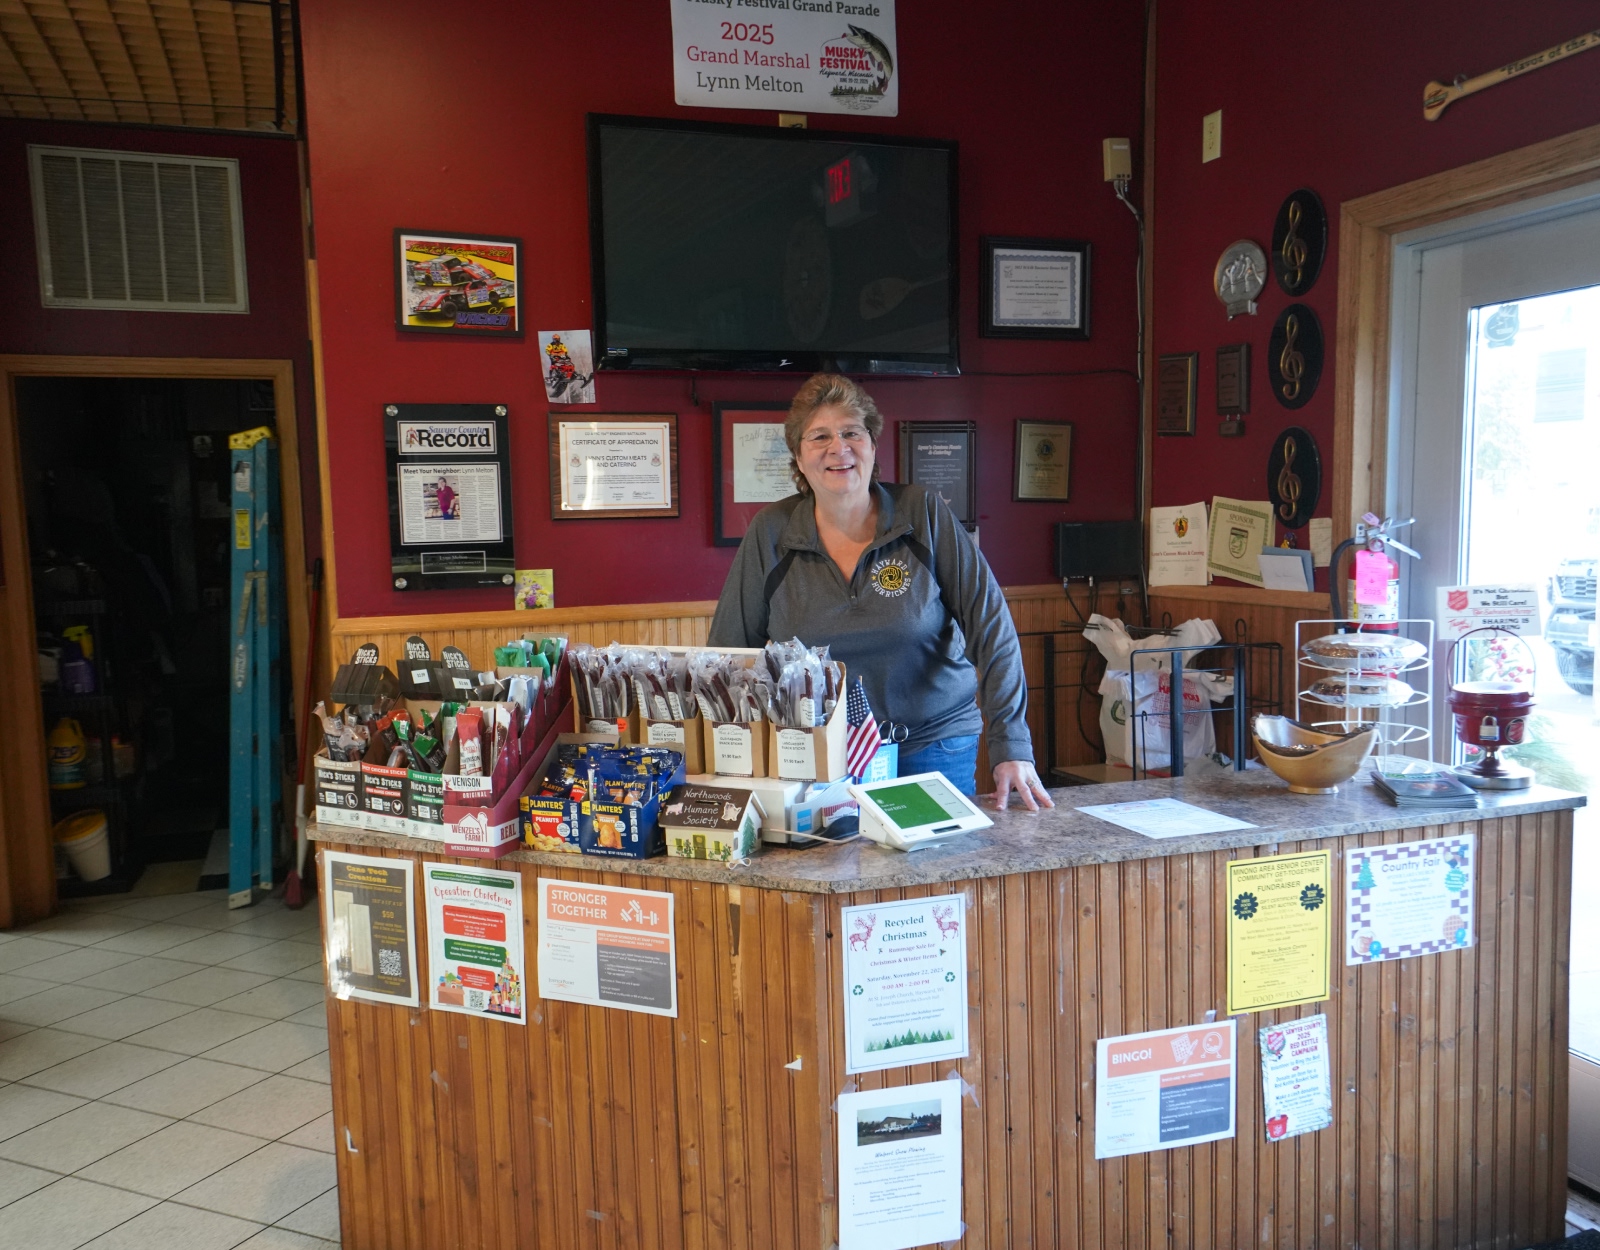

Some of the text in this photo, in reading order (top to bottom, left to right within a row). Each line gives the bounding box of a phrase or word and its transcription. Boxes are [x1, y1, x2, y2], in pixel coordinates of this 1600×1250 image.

[793, 1, 833, 14] Grand
[836, 4, 880, 17] Parade
[720, 22, 775, 45] 2025
[687, 45, 811, 70] Grand Marshal
[825, 46, 866, 58] MUSKY
[820, 57, 871, 70] FESTIVAL
[696, 71, 804, 93] Lynn Melton
[428, 425, 486, 436] Sawyer County
[416, 427, 492, 448] Record
[433, 467, 462, 475] Neighbor:
[462, 467, 475, 475] Lynn
[871, 558, 908, 575] HAYWARD
[871, 577, 911, 598] HURRICANES
[1482, 617, 1519, 625] SHARING
[354, 656, 378, 665] STICKS
[408, 650, 430, 660] STICKS
[446, 658, 469, 669] STICKS
[318, 769, 355, 781] NICK'S STICKS
[389, 768, 407, 776] STICKS
[364, 775, 403, 788] NICK'S STICKS
[410, 781, 427, 792] NICK'S
[452, 776, 481, 788] VENISON
[684, 788, 732, 800] Northwoods
[530, 799, 564, 810] PLANTERS
[592, 803, 623, 814] PLANTERS
[683, 804, 719, 815] Humane
[683, 815, 719, 828] Society
[452, 825, 481, 836] WENZEL'S
[501, 823, 517, 840] REAL
[464, 833, 481, 842] FARM
[1233, 858, 1324, 876] MINONG AREA SENIOR CENTER
[1381, 857, 1440, 873] Country Fair
[367, 867, 388, 876] Tech
[1237, 866, 1320, 883] COMMUNITY GET-TOGETHER
[348, 873, 387, 884] Creations
[1257, 880, 1301, 892] FUNDRAISER
[434, 885, 471, 900] Operation
[473, 887, 513, 907] Christmas
[551, 889, 607, 906] STRONGER
[1270, 895, 1299, 904] CERTIFICATE
[551, 903, 607, 920] TOGETHER
[1261, 901, 1298, 911] SILENT AUCTION
[884, 915, 924, 929] Recycled
[882, 930, 928, 943] Christmas
[889, 945, 915, 954] Rummage
[870, 958, 897, 967] Christmas
[866, 974, 893, 983] Saturday,
[893, 970, 920, 979] November
[1252, 994, 1274, 1004] FOOD
[1286, 1021, 1321, 1035] SAWYER COUNTY
[1297, 1031, 1311, 1040] 2025
[1290, 1037, 1319, 1050] RED KETTLE
[1112, 1048, 1152, 1065] BINGO!
[1291, 1045, 1318, 1057] CAMPAIGN
[1283, 1078, 1295, 1087] Kettle
[1295, 1075, 1310, 1083] Basket
[907, 1146, 926, 1155] Plowing
